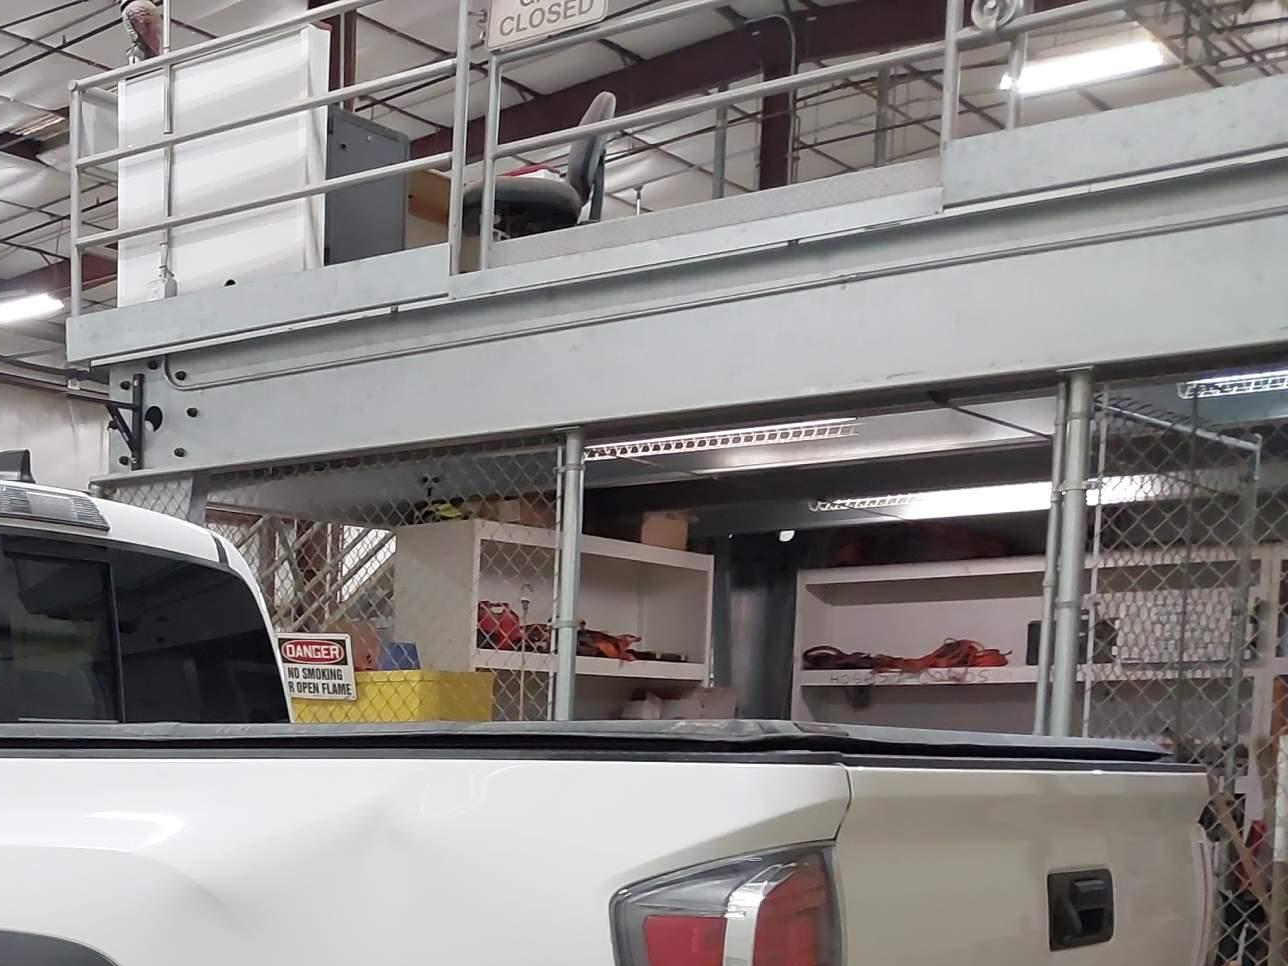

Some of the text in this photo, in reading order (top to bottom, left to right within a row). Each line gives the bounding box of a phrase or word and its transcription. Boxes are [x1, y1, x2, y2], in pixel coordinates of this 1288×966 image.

[499, 0, 595, 36] CLOSED
[285, 644, 340, 659] DANGER
[287, 667, 343, 680] NO SMOKING
[296, 682, 319, 694] OPEN
[321, 683, 352, 695] FLAME
